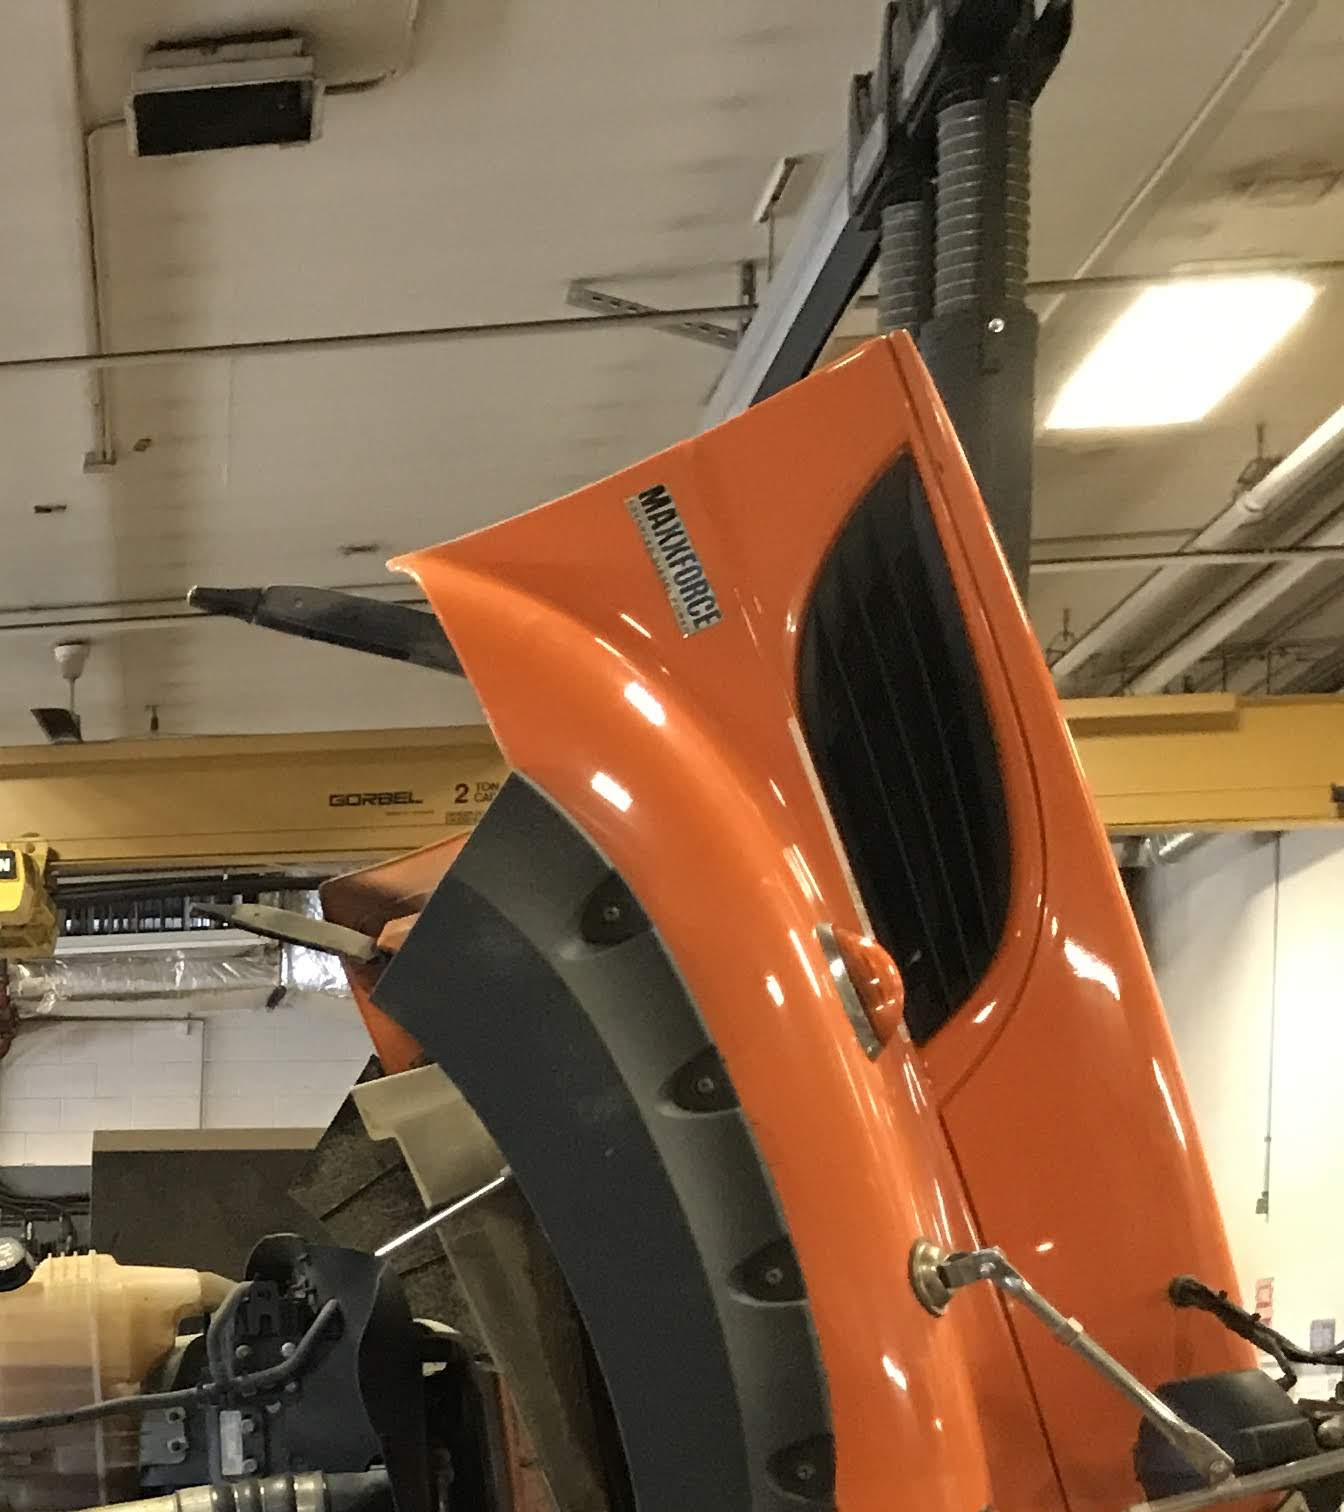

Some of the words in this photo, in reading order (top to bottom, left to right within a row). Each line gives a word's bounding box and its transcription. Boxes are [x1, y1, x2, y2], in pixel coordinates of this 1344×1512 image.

[638, 484, 722, 629] MAXXFORCE
[329, 791, 424, 807] GORBEL
[454, 783, 469, 804] 2
